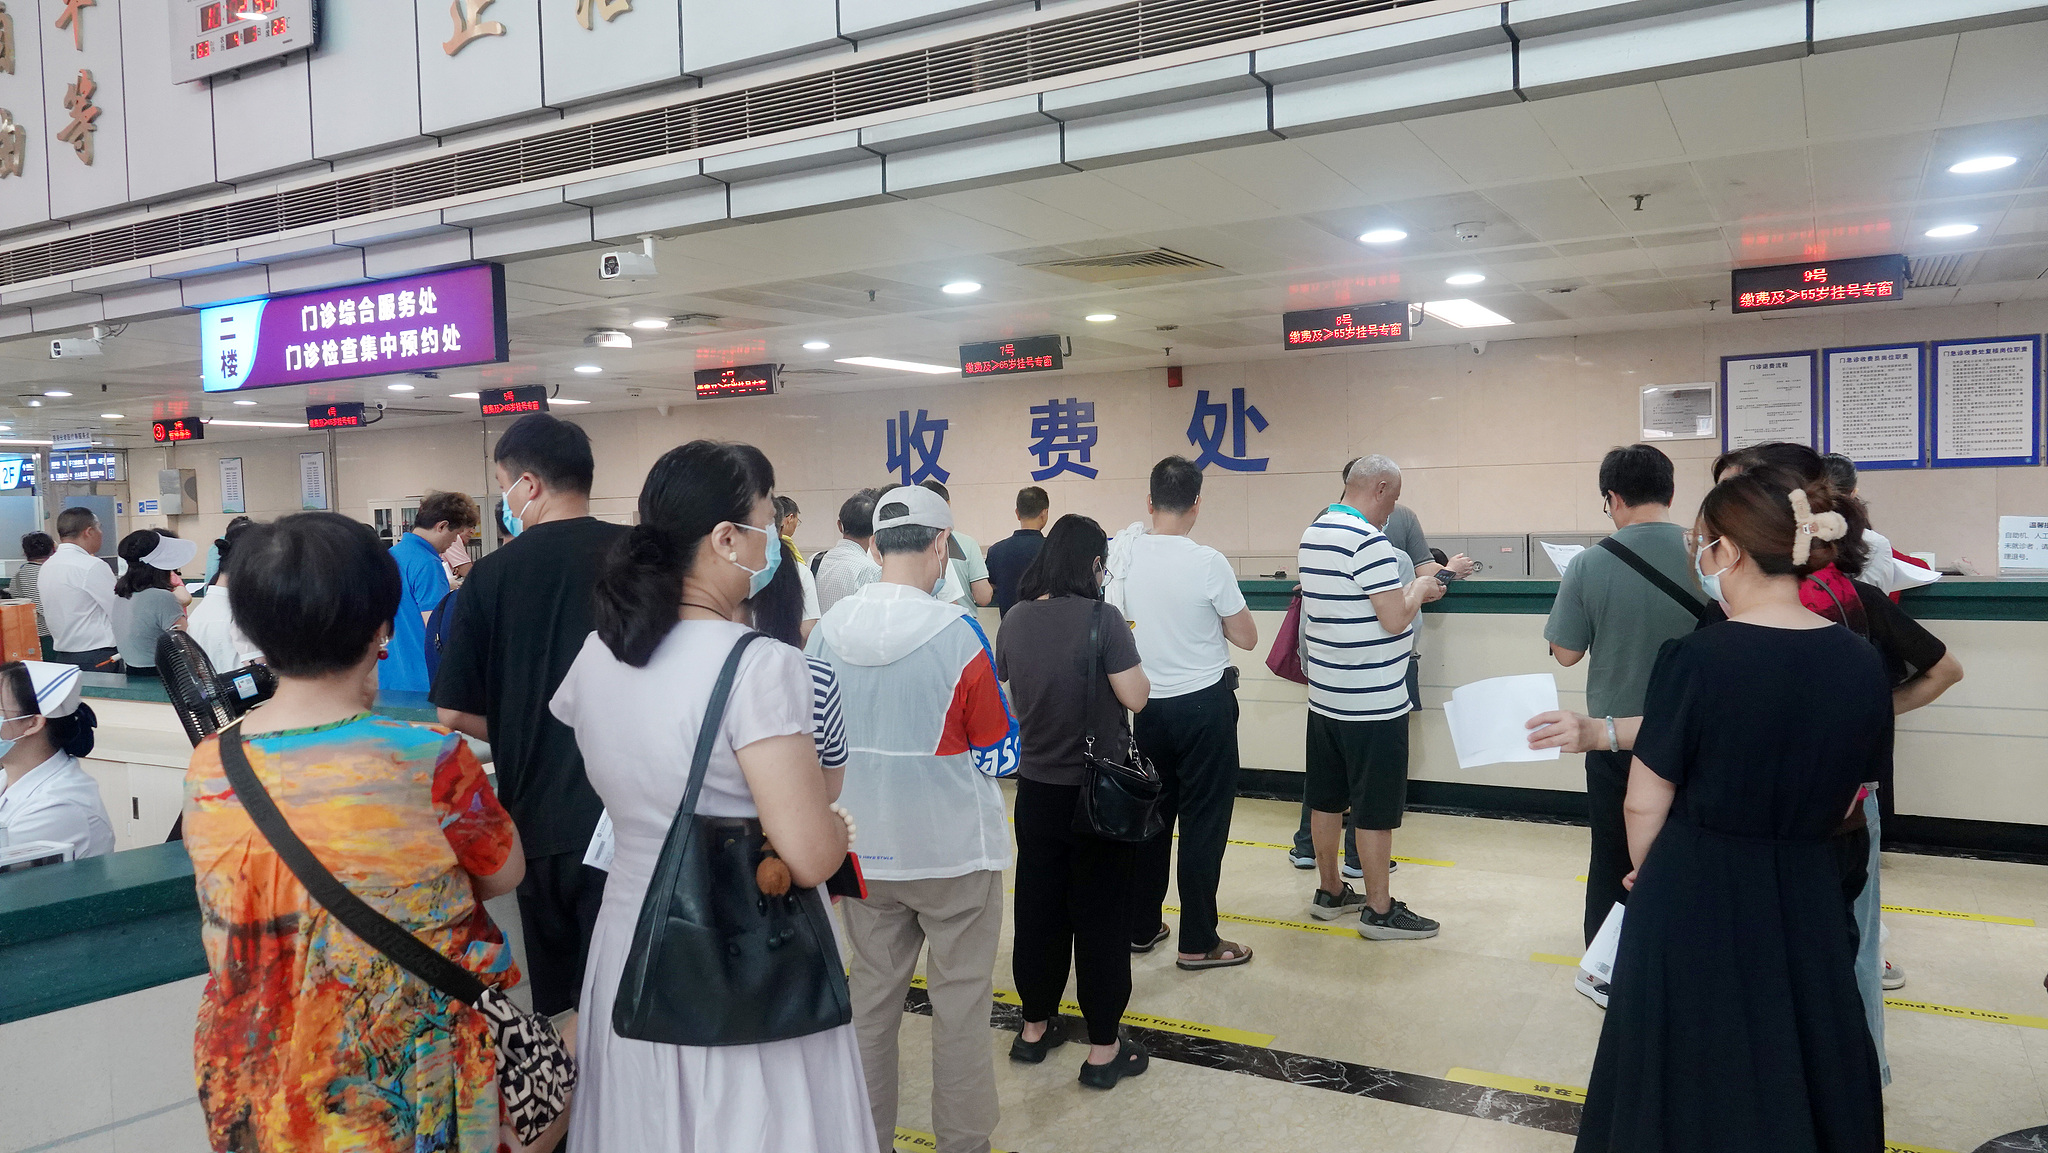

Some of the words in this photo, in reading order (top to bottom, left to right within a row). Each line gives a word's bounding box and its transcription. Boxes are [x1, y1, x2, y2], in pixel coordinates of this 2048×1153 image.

[1803, 268, 1828, 283] 9号
[301, 286, 438, 332] 门诊综合服务处
[1336, 313, 1353, 327] 8号
[220, 316, 238, 378] 二楼
[285, 323, 461, 371] 门诊检查集中预约处
[999, 343, 1015, 357] 7号
[885, 387, 1269, 486] 收费处
[3, 466, 15, 484] 2F
[1232, 916, 1276, 925] Beyond
[1303, 924, 1329, 932] Line
[1884, 1000, 1925, 1009] yond
[1930, 1005, 1965, 1014] The
[1970, 1011, 2009, 1020] Line
[1152, 1019, 1178, 1027] The
[1180, 1023, 1211, 1033] Line
